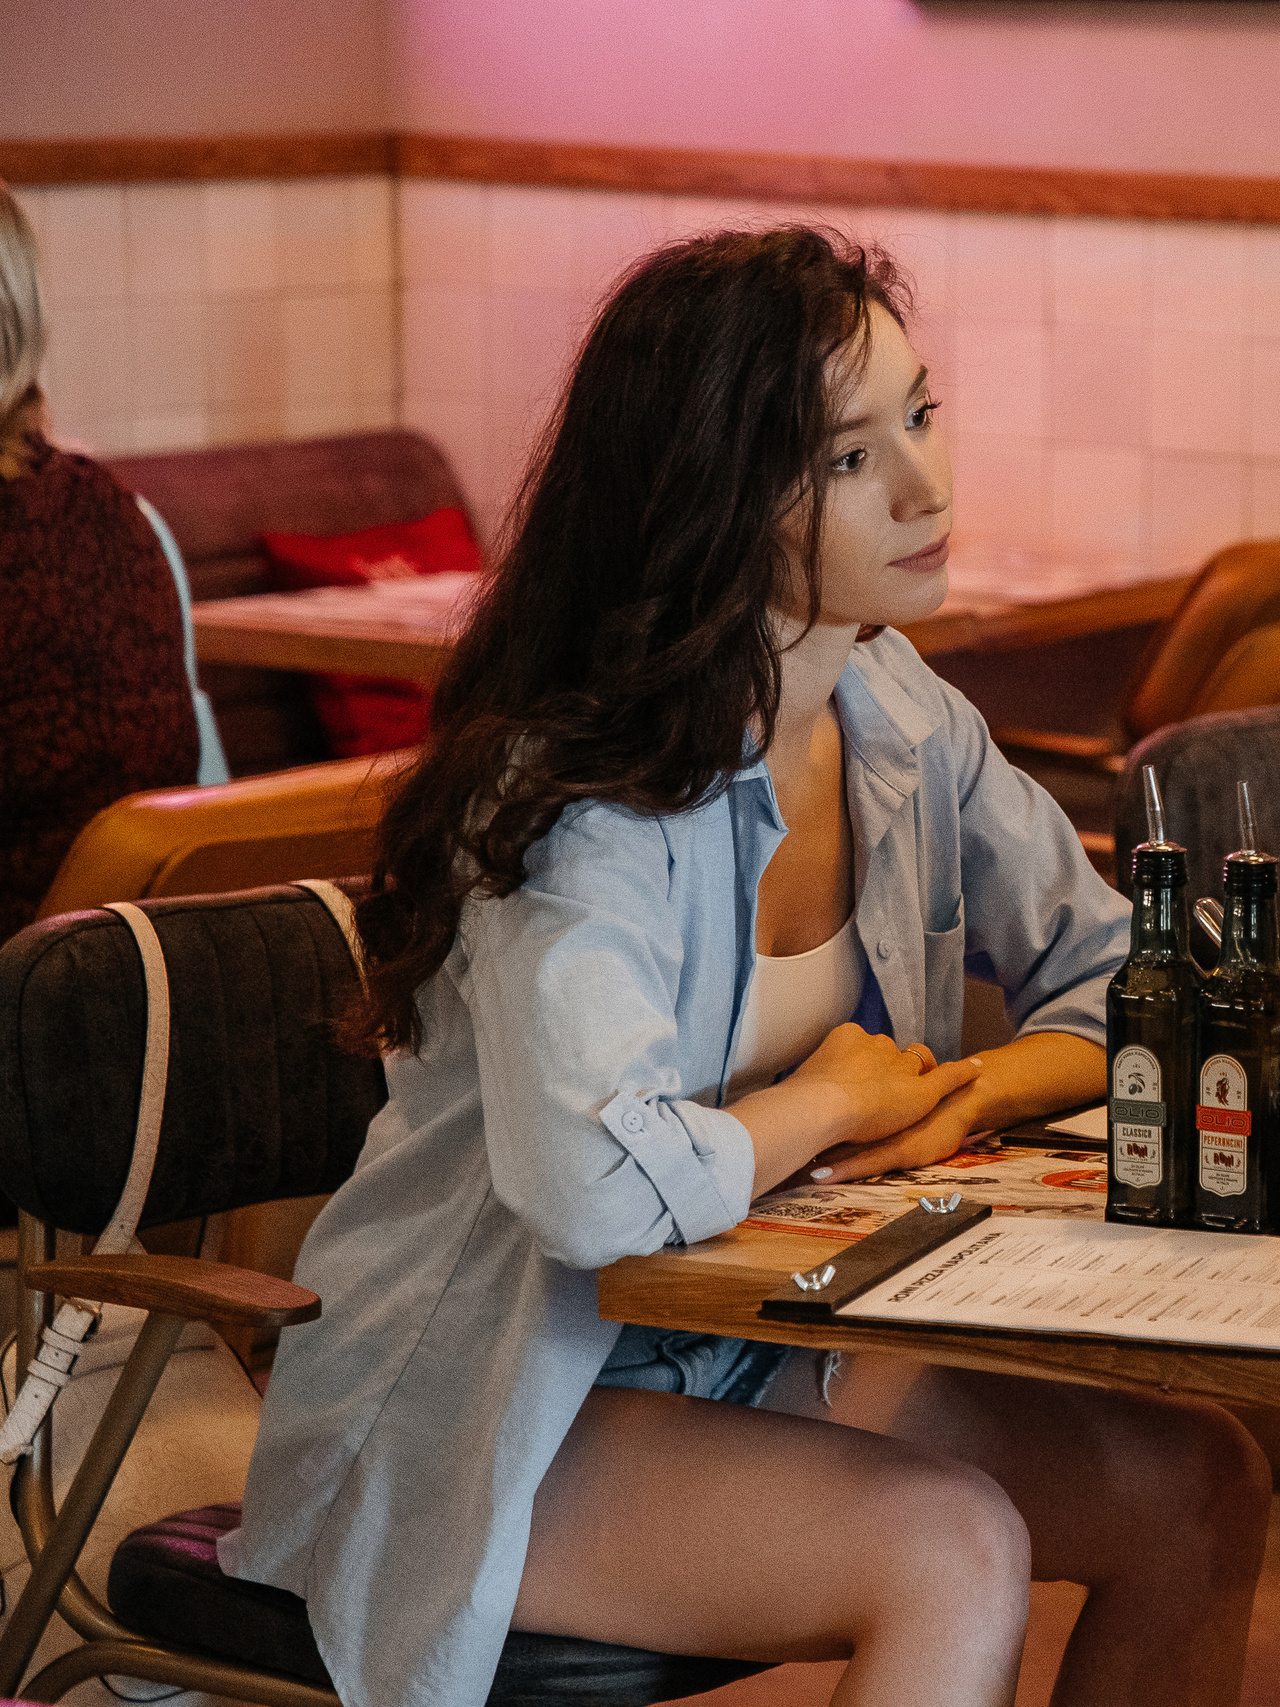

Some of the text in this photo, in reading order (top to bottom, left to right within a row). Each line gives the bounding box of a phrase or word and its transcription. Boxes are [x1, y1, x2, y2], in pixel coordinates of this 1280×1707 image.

[1114, 1106, 1160, 1119] OLIO
[1201, 1114, 1246, 1128] OLIO
[910, 1269, 947, 1287] PIZZA
